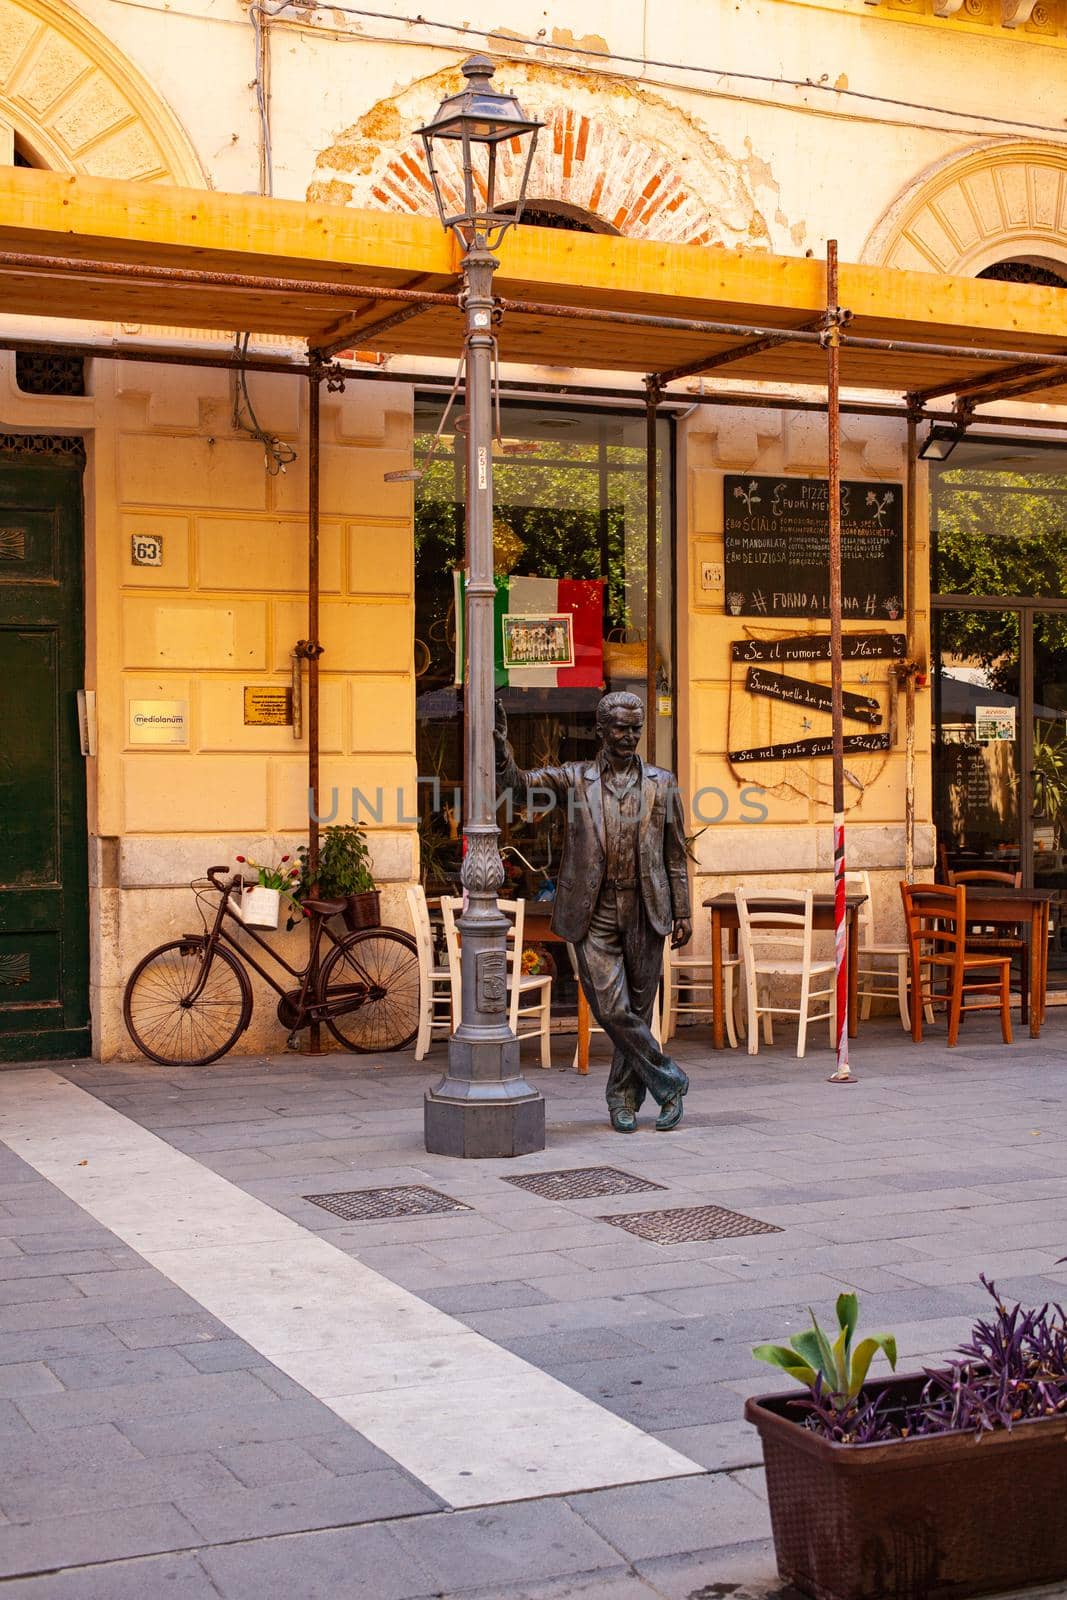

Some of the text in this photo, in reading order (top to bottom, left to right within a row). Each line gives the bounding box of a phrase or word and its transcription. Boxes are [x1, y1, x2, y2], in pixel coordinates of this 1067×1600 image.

[783, 501, 809, 512] FUORI
[137, 543, 157, 559] 63
[742, 552, 787, 564] DELIZIOSA
[773, 592, 807, 609] FORNO
[810, 596, 818, 609] A
[745, 641, 763, 660] Se
[770, 643, 780, 658] il
[786, 649, 821, 659] rumore
[850, 641, 882, 656] Mare
[804, 689, 817, 704] dei
[136, 715, 184, 724] mediolanum
[760, 747, 775, 758] nel
